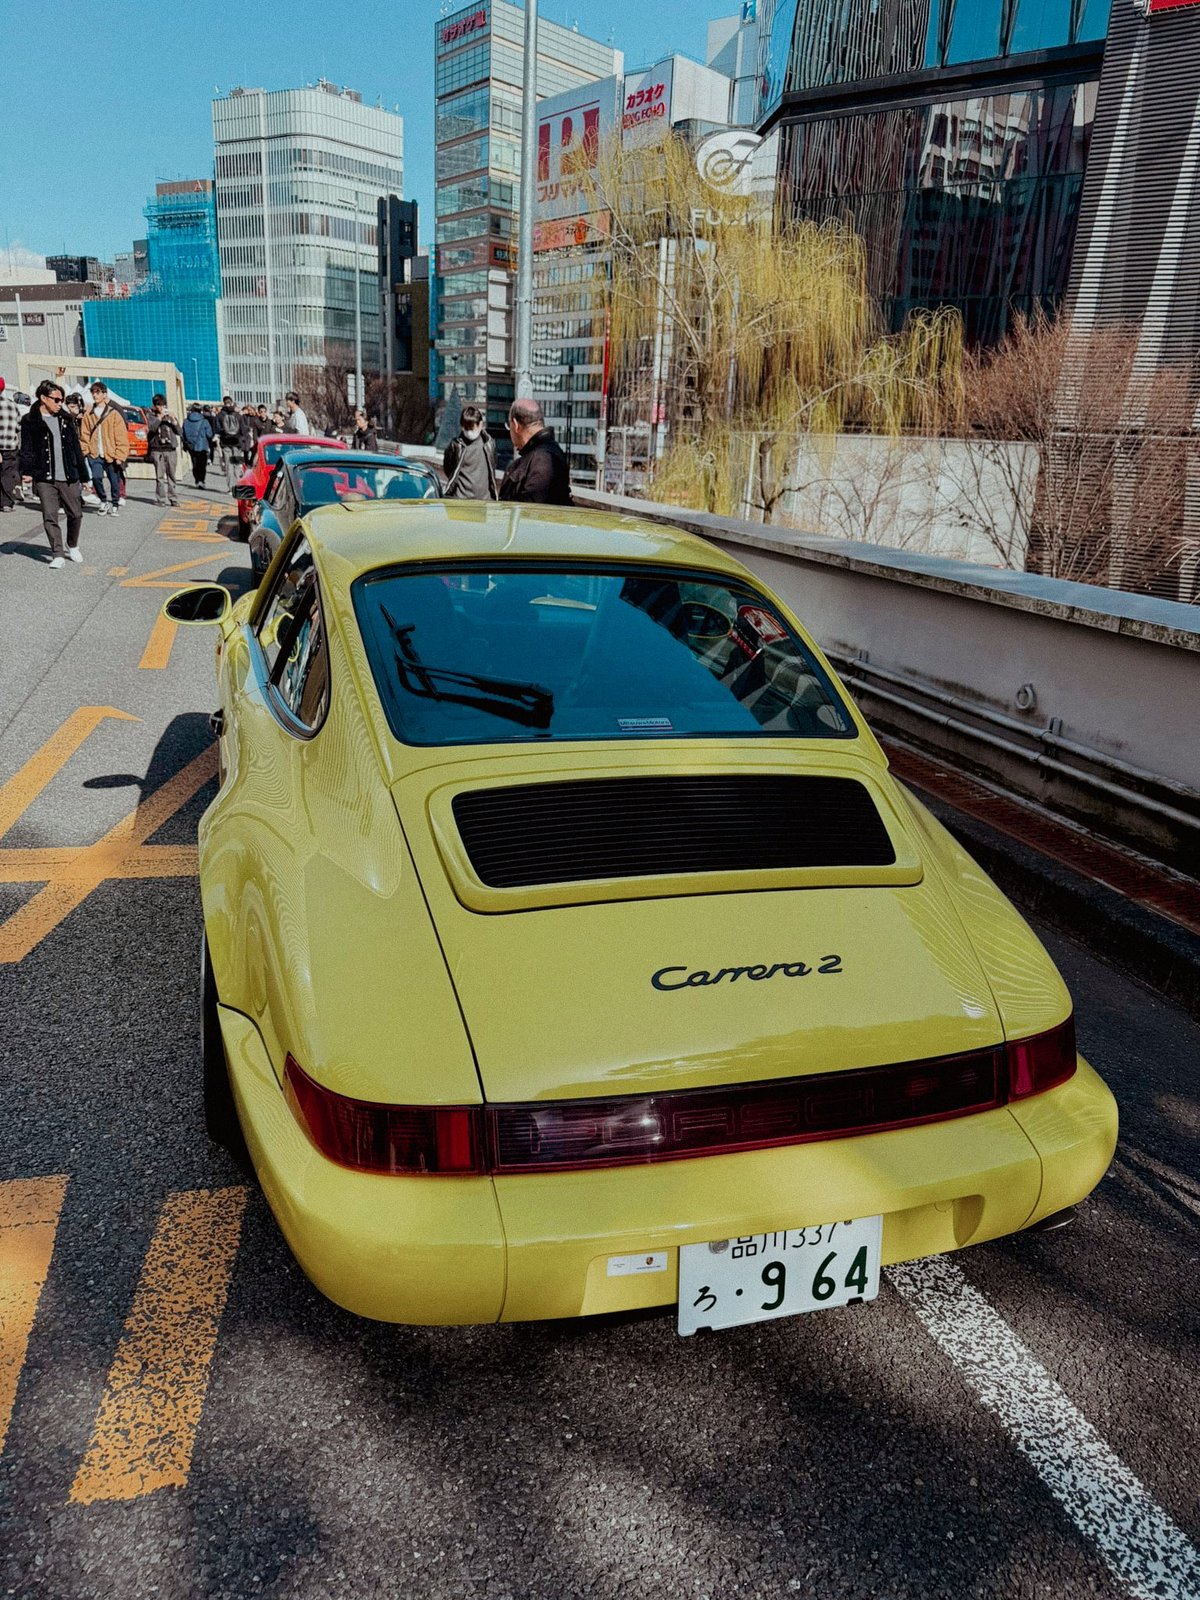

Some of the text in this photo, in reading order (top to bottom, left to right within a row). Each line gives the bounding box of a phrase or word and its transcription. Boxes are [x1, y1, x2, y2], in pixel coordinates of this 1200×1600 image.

[626, 83, 665, 110] カラオケ
[651, 954, 843, 991] Carrera 2
[731, 1230, 787, 1259] 品川
[693, 1286, 717, 1312] ろ
